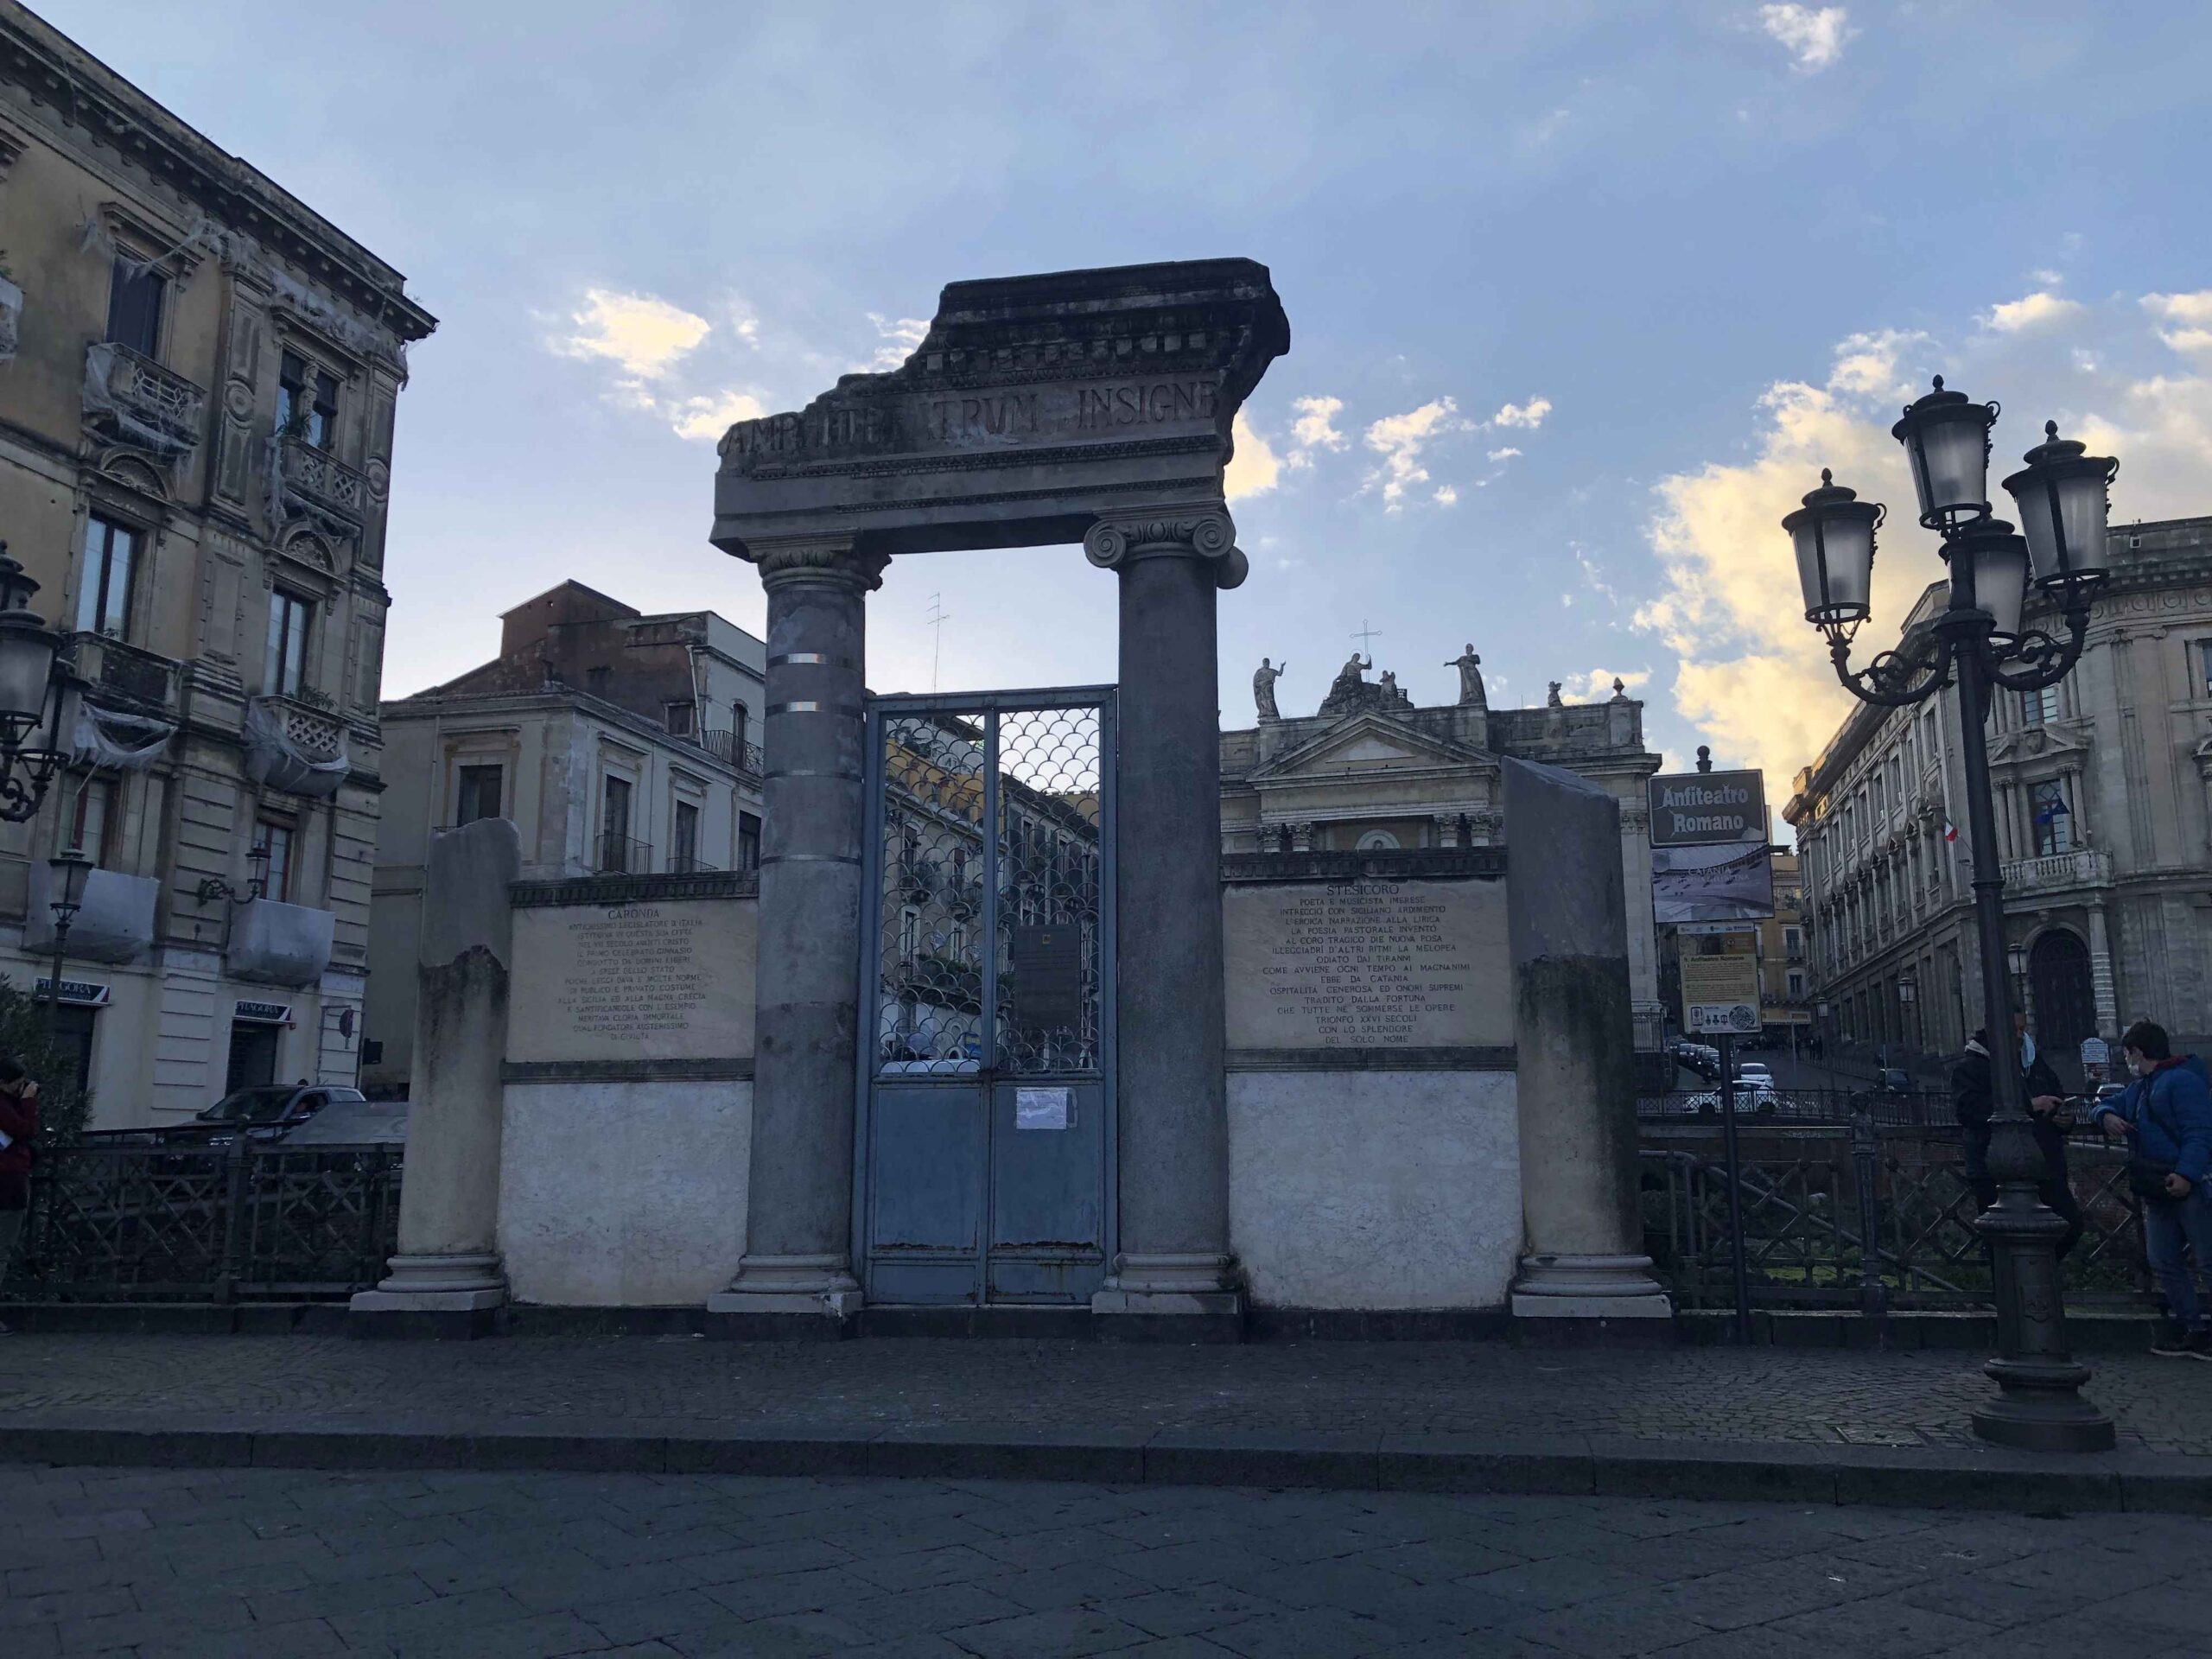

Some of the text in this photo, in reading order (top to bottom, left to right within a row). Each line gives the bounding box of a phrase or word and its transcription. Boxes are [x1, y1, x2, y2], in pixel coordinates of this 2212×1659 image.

[1077, 379, 1219, 430] INSIGNE
[1662, 784, 1749, 807] Anfiteatro
[1673, 813, 1745, 832] Romano
[1327, 885, 1399, 895] STESICORO
[1389, 895, 1425, 904] IMERESE
[608, 908, 660, 919] CARONDA
[1329, 916, 1380, 925] NARRAZIONE
[1300, 936, 1324, 944] CORO
[1369, 944, 1392, 953] RITMI
[1316, 955, 1349, 963] ODIATO
[1262, 966, 1287, 975] COME
[1294, 965, 1330, 974] AVVIENE
[1367, 964, 1395, 973] TEMPO
[1421, 963, 1470, 972] MAGNANIMI
[35, 978, 90, 994] PITGORA
[1428, 983, 1464, 992] SUPREMI
[1304, 994, 1426, 1004] TRADITO DALLA FORTUNA
[1426, 1003, 1456, 1012] OPERE
[1319, 1024, 1413, 1033] CON LO SPLENDORE
[1383, 1034, 1409, 1043] NOME
